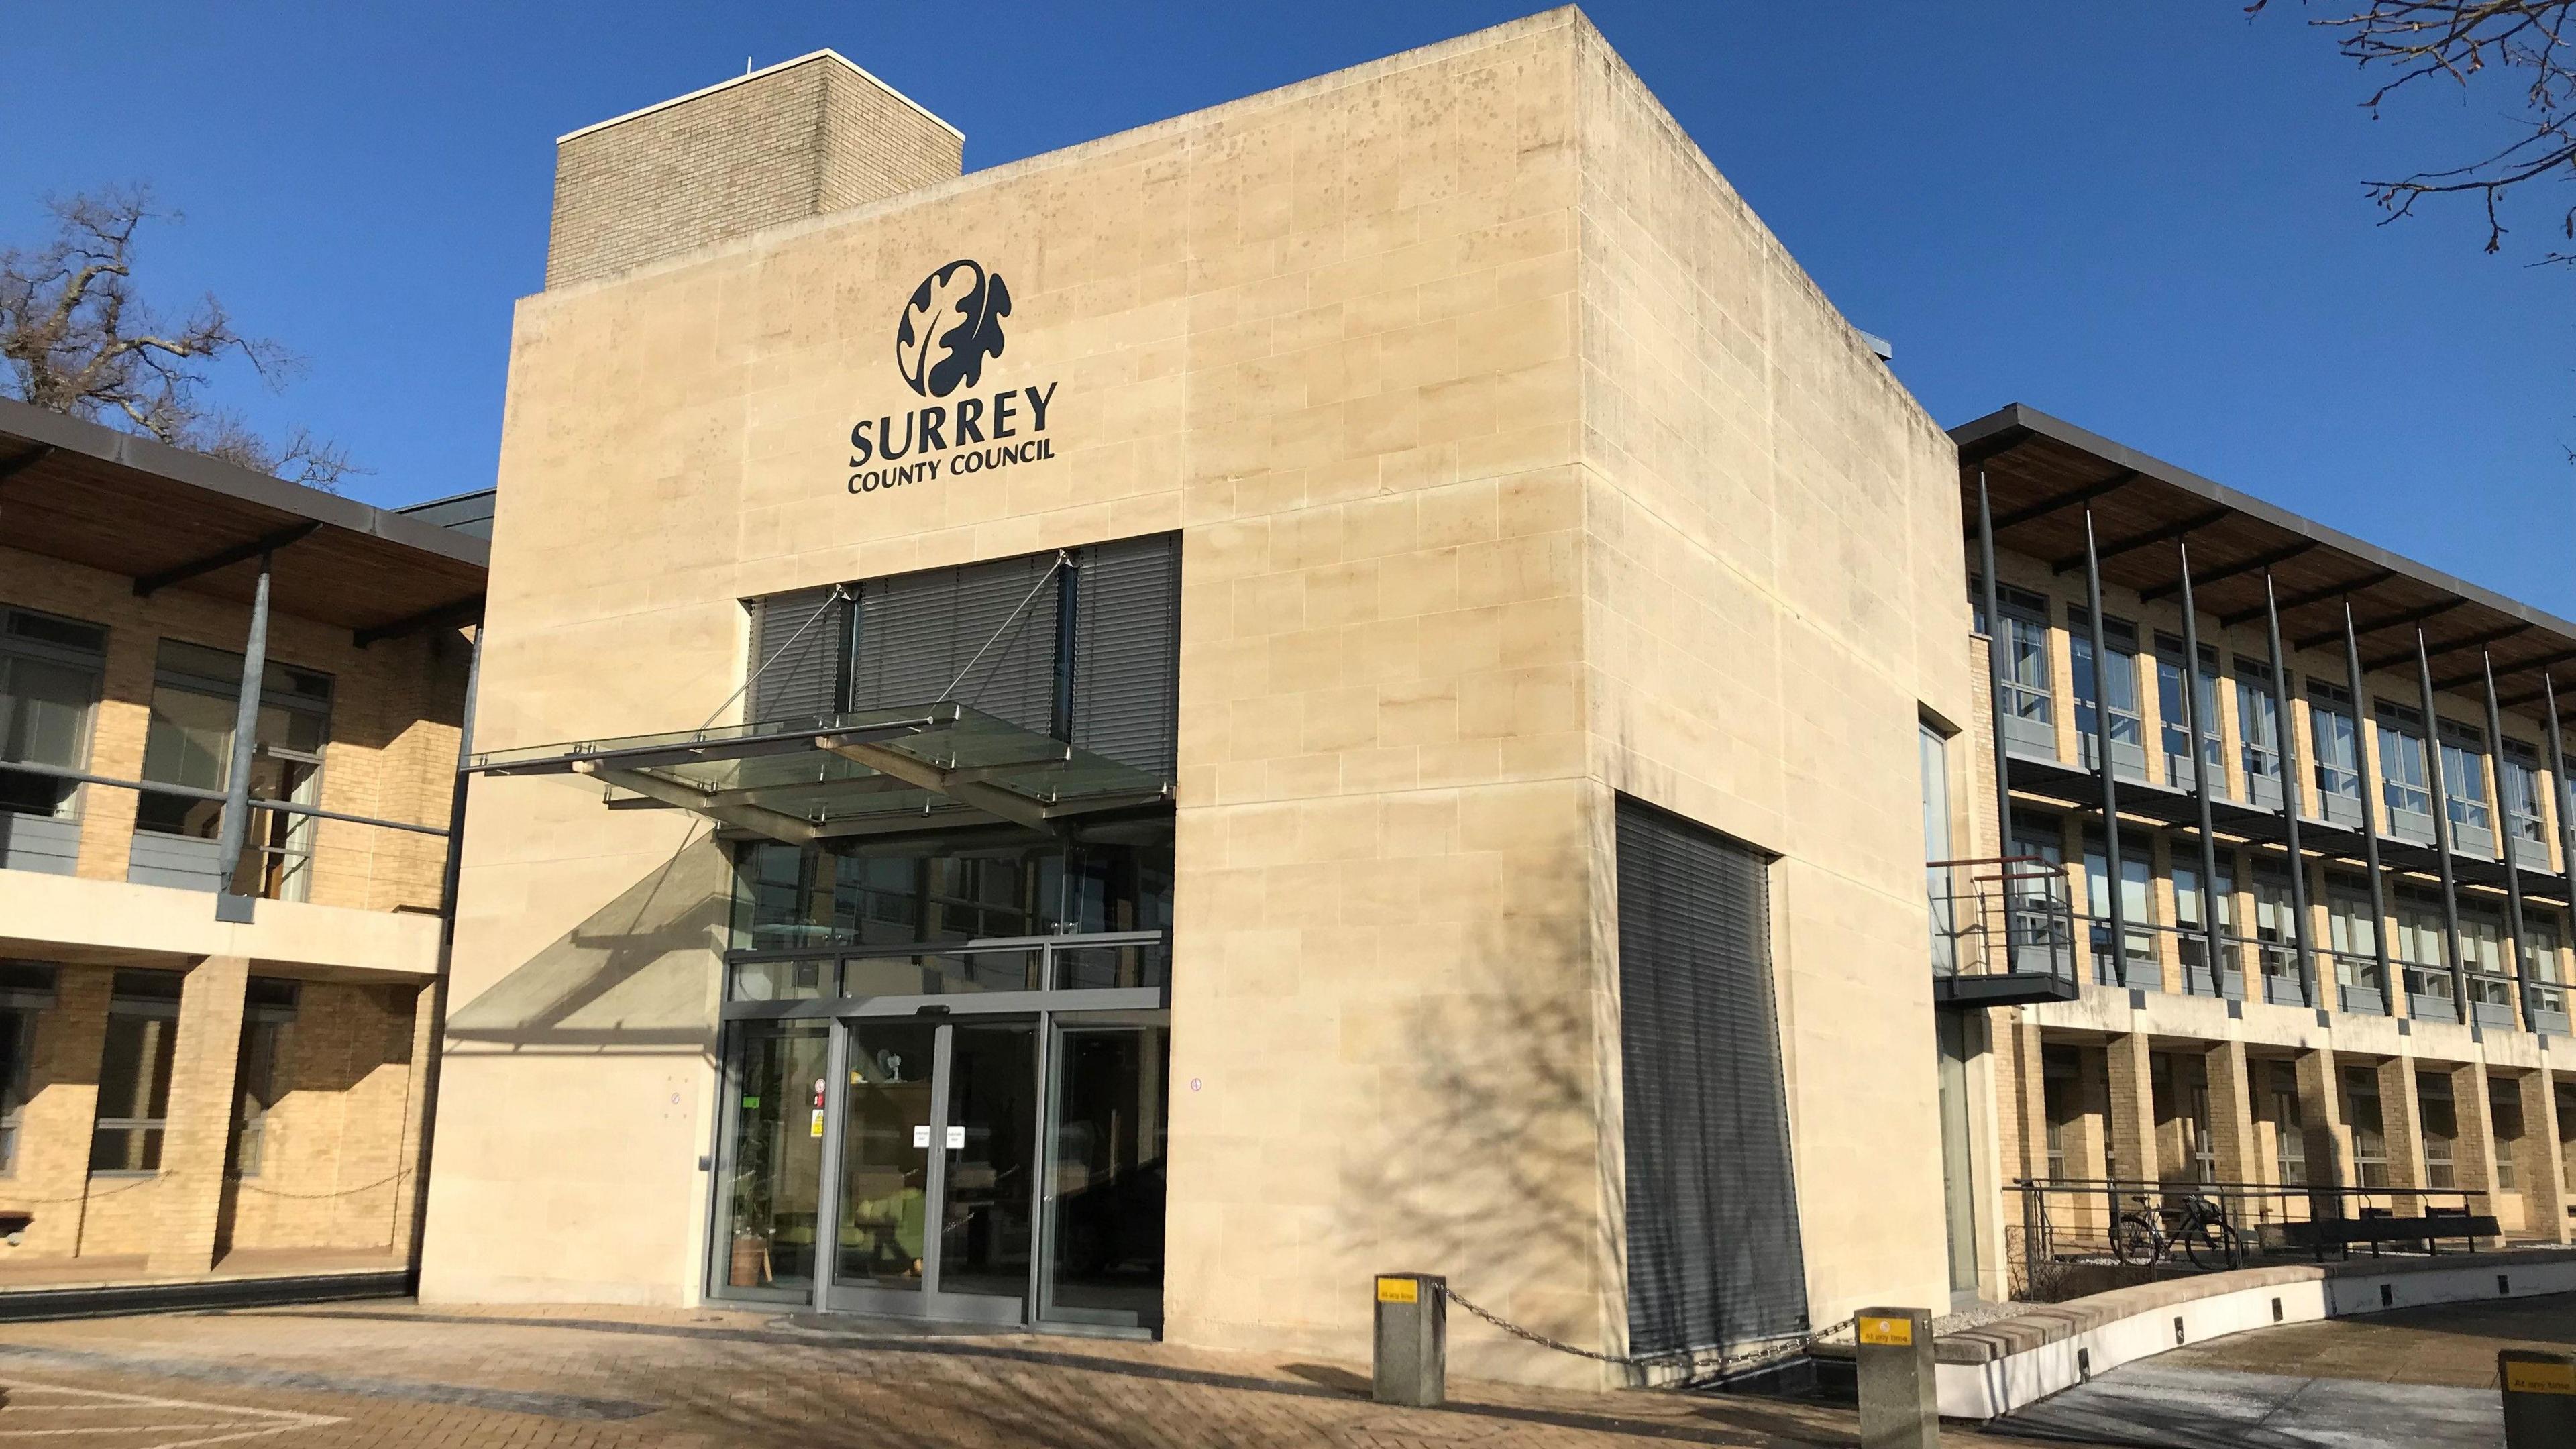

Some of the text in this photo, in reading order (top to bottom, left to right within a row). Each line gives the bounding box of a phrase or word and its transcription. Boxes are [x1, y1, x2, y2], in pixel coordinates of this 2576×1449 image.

[849, 381, 1058, 468] SURREY
[847, 438, 1055, 494] COUNTY COUNCIL
[1890, 1334, 1908, 1342] time
